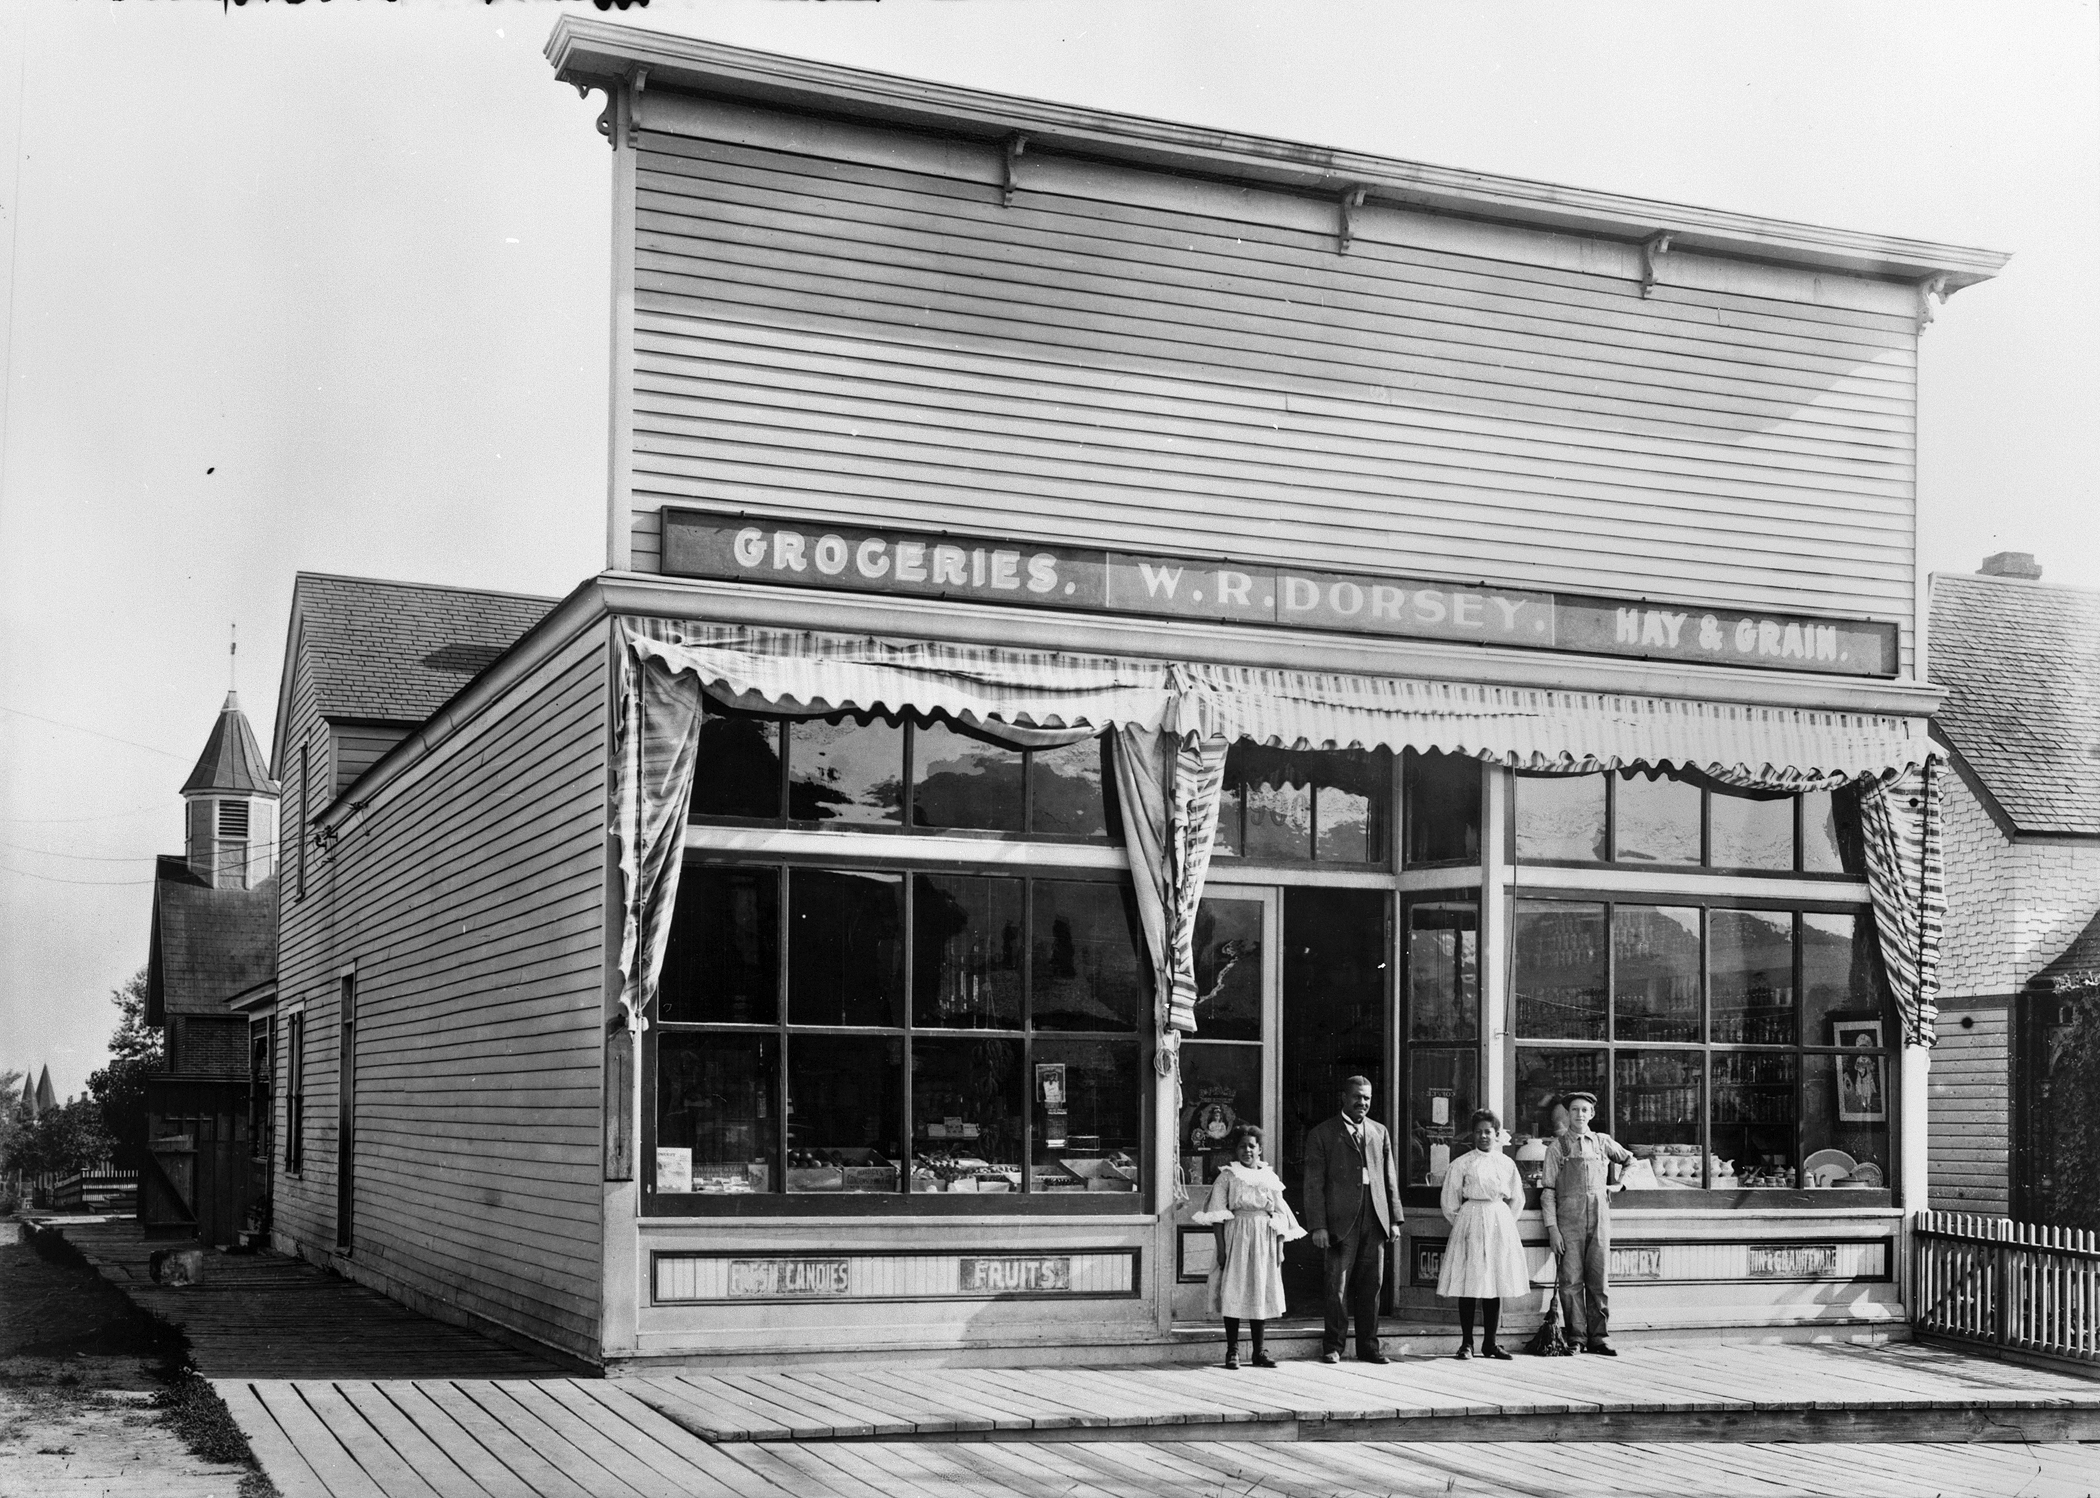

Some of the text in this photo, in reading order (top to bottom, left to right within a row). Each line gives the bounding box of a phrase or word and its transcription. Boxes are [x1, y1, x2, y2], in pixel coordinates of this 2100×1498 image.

[733, 527, 1076, 595] GROCERIES.
[1138, 562, 1546, 632] W. R. DORSEY.
[1616, 607, 1849, 662] HAY & GRAIN.
[785, 1262, 848, 1290] CANDIES
